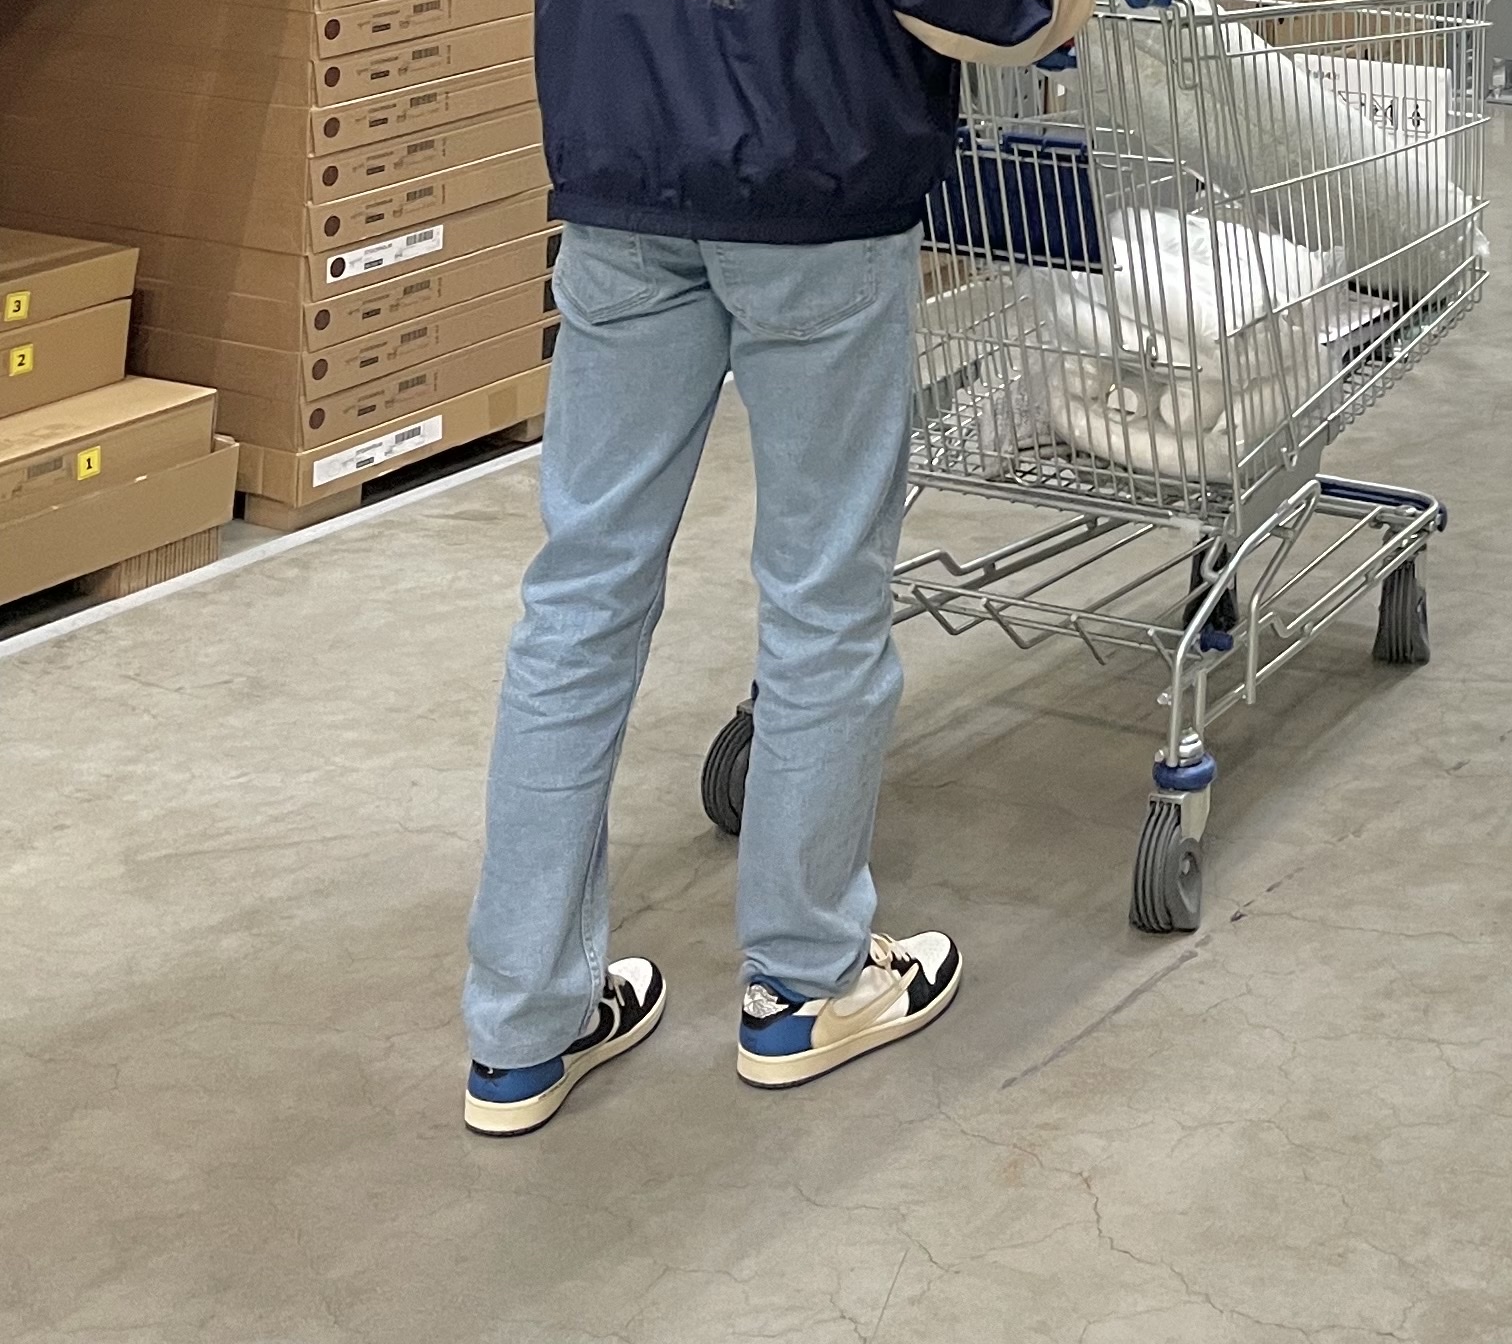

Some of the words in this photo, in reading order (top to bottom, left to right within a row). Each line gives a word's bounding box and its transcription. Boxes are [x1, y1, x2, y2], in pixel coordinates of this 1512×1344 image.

[12, 299, 22, 313] 3
[17, 353, 26, 367] 2
[85, 457, 93, 470] 1
